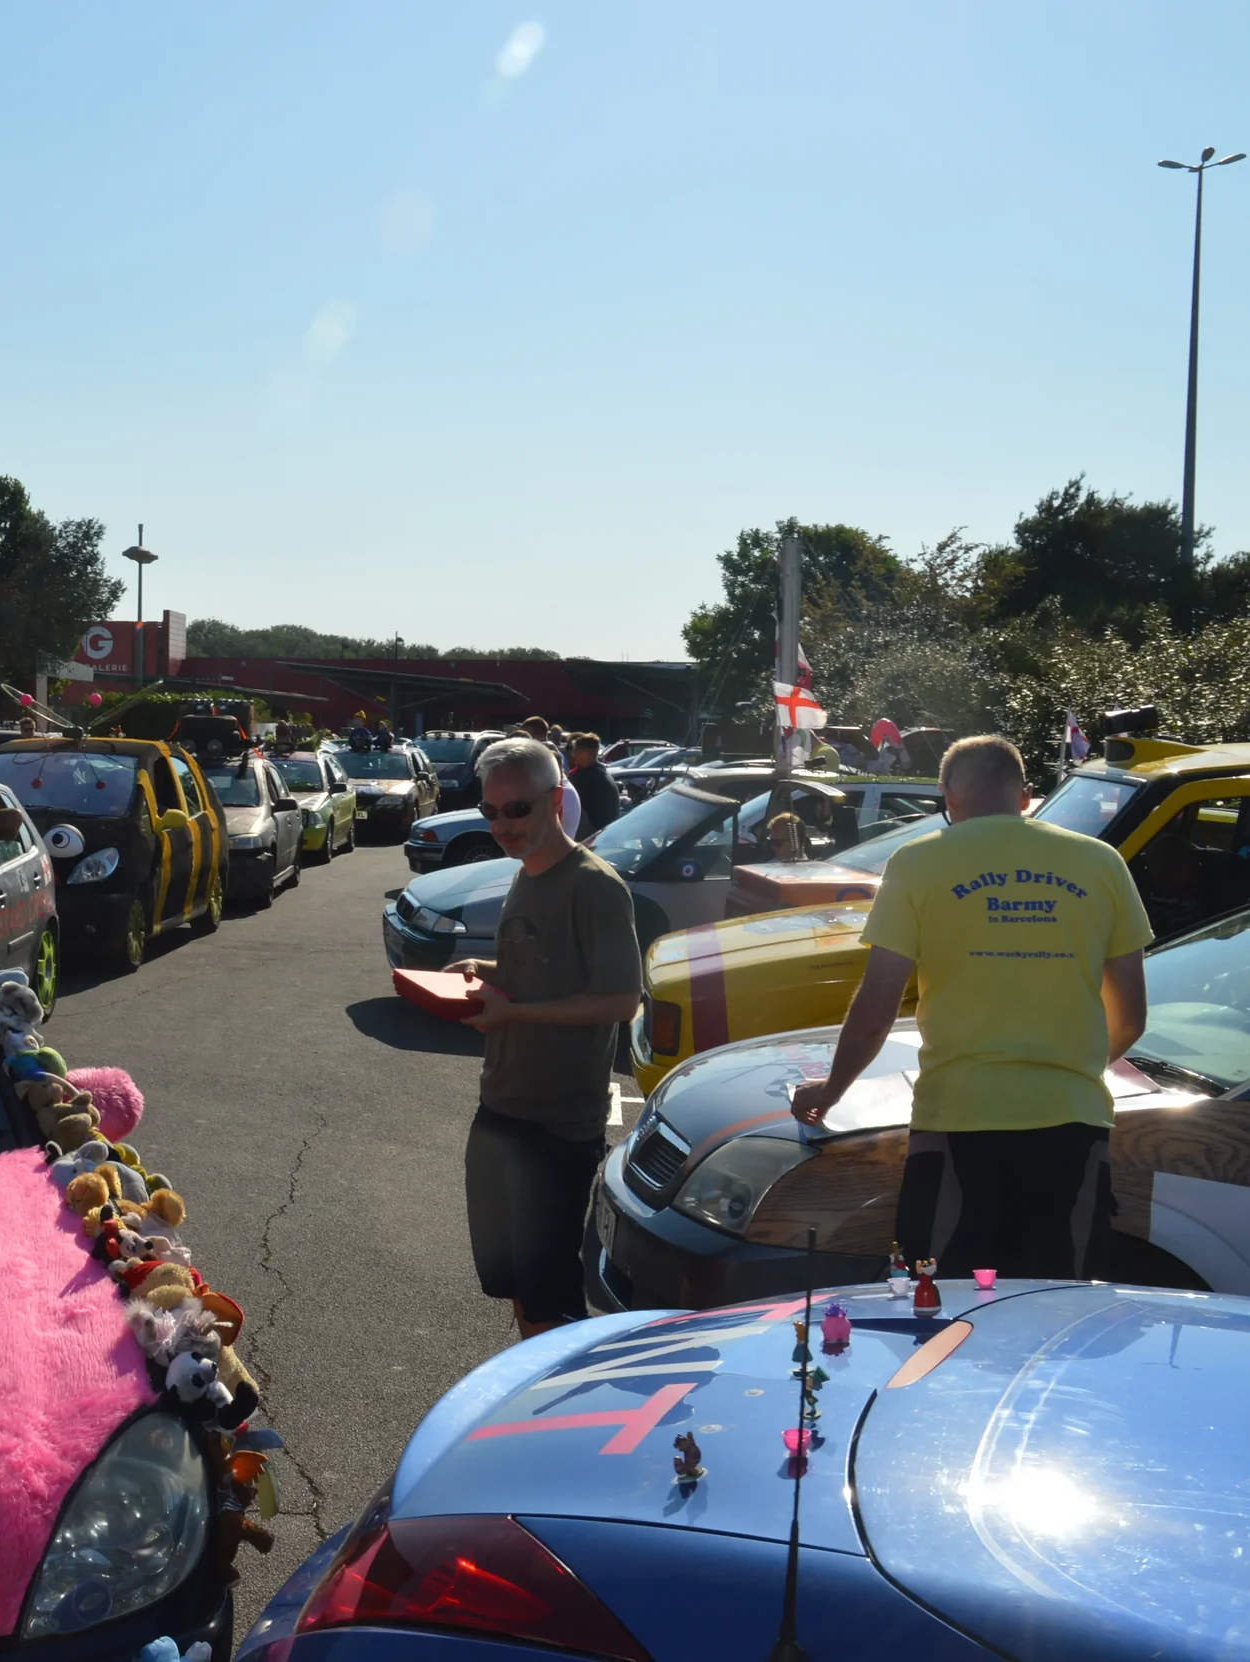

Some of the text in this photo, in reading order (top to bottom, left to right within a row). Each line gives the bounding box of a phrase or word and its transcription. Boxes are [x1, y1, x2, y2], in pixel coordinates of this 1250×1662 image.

[951, 869, 1087, 900] Rally Driver
[986, 897, 1057, 913] Barmy
[1001, 915, 1057, 923] Barcelona
